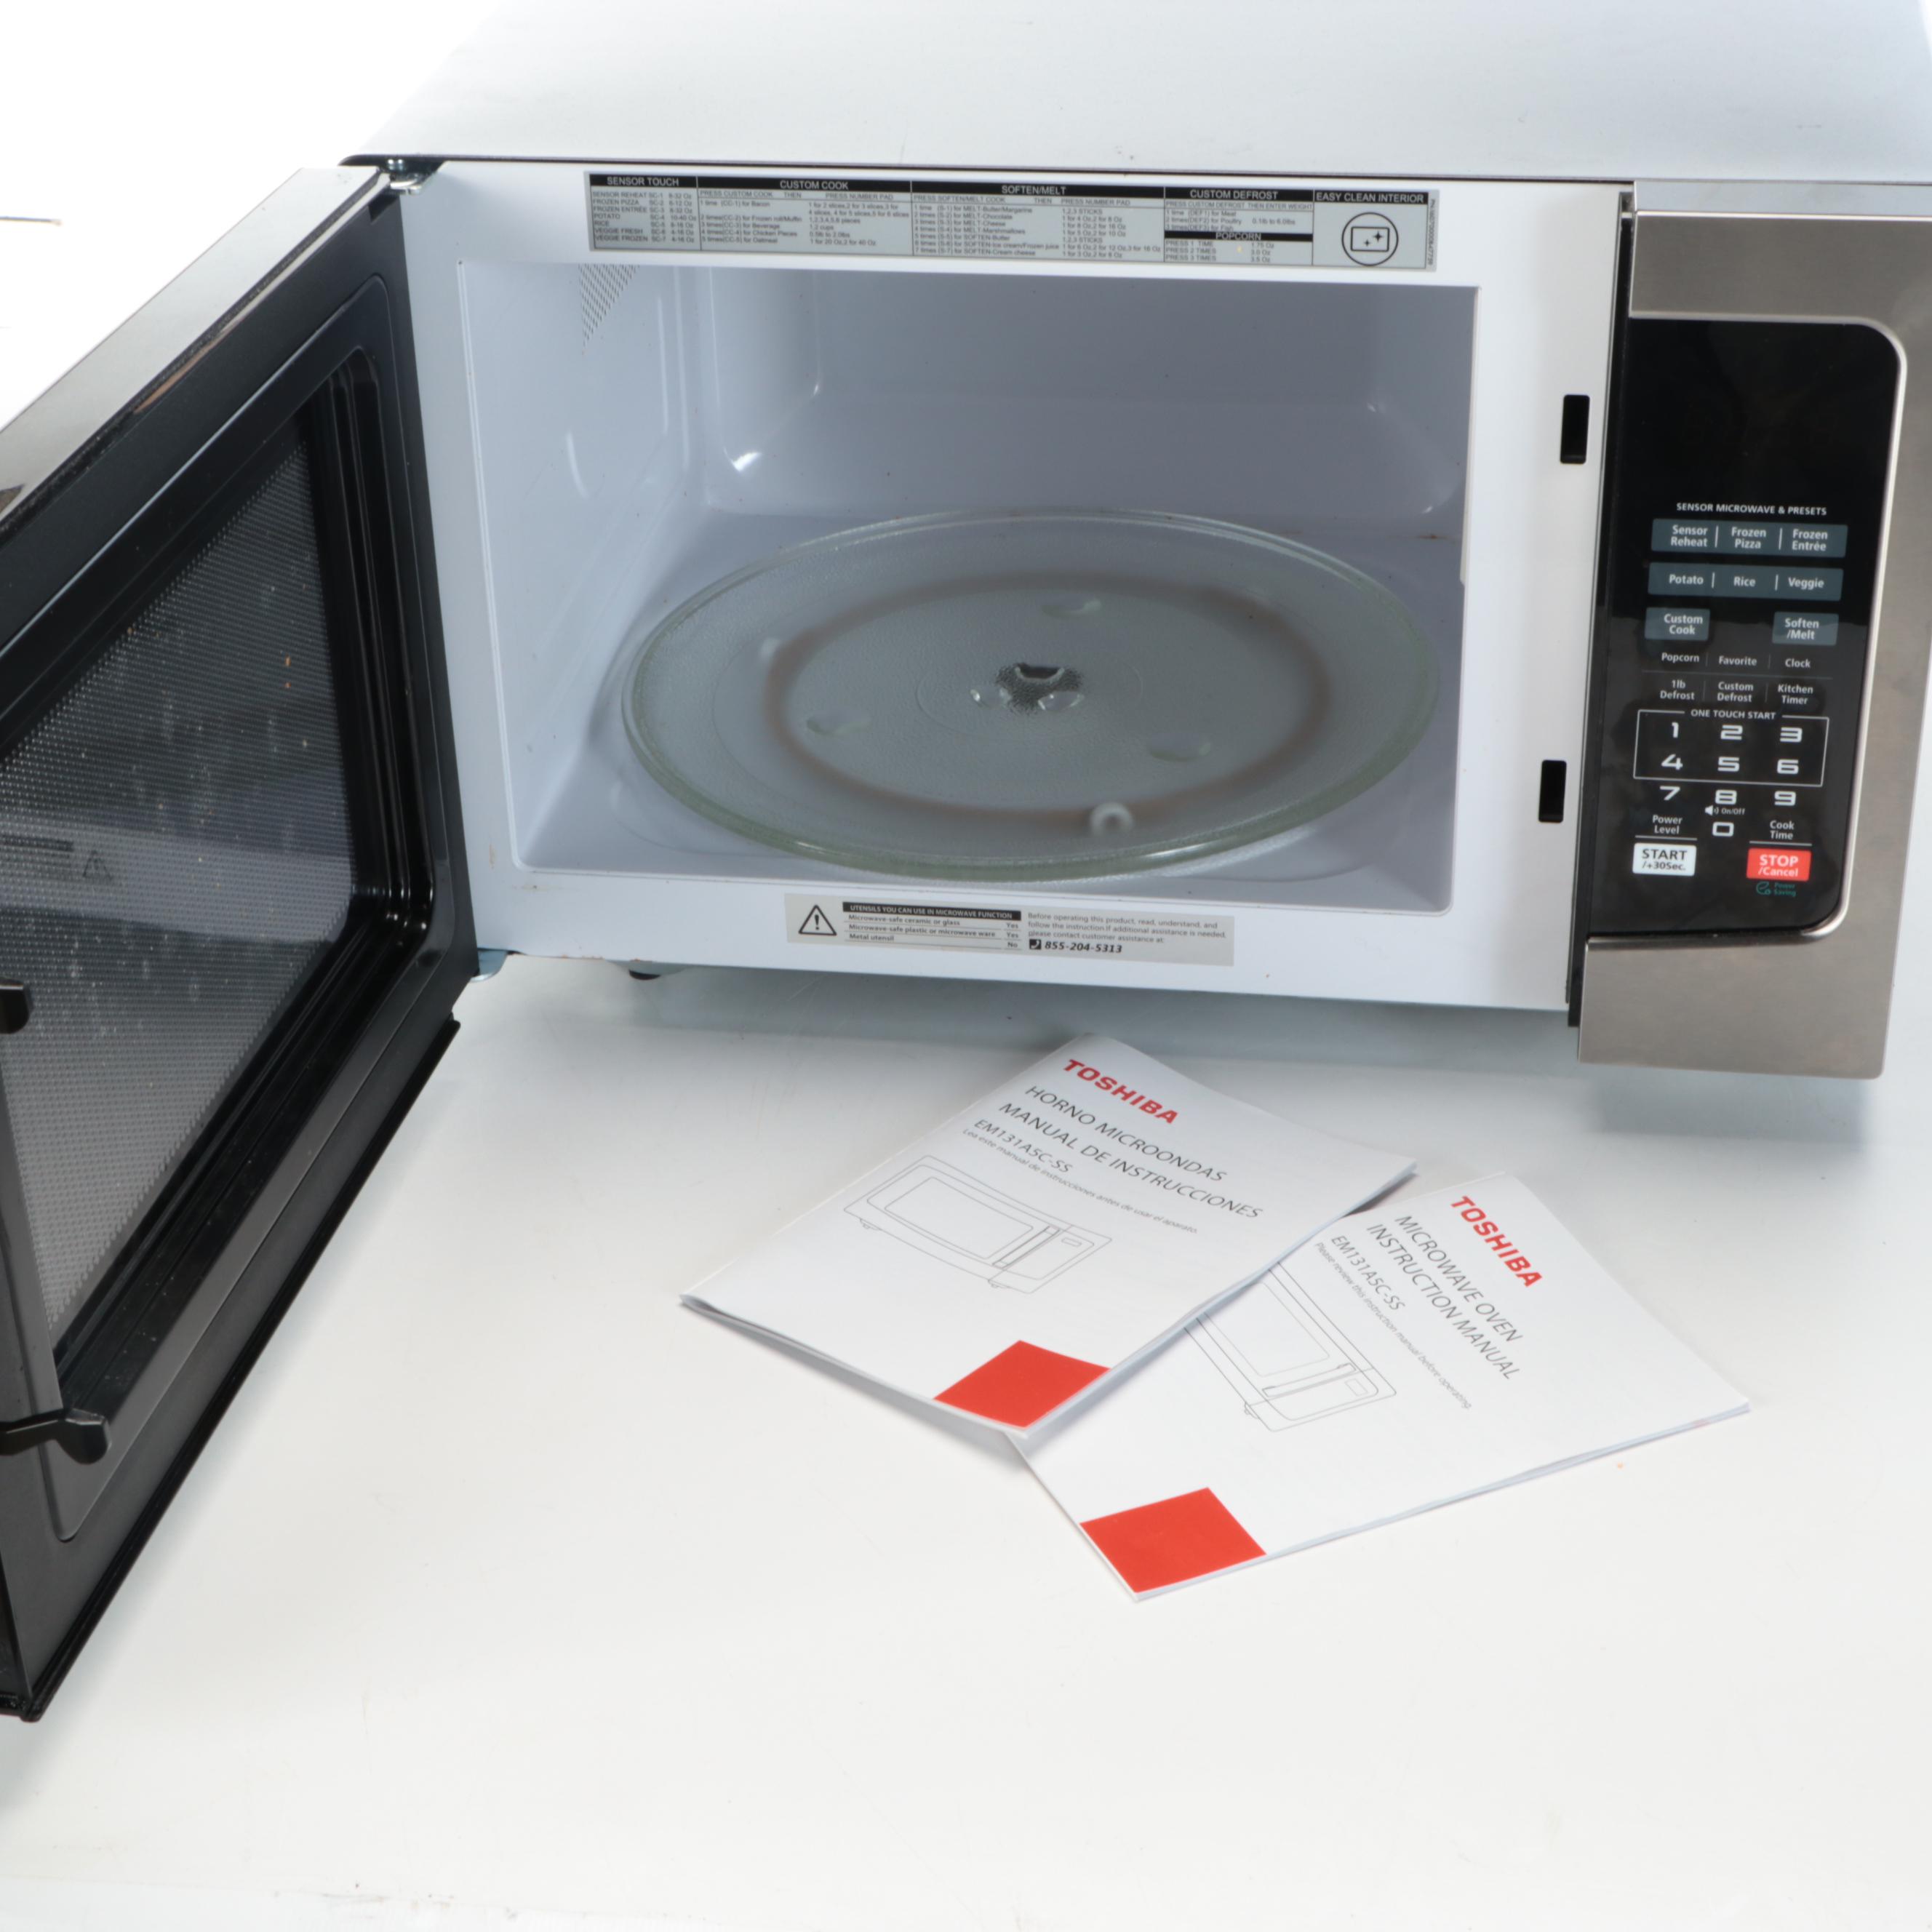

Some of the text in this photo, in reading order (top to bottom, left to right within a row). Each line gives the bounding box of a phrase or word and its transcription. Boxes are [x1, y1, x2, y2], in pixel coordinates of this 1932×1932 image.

[607, 177, 679, 186] SENSOR TOUCH
[780, 180, 848, 190] CUSTOM COOK
[1002, 185, 1066, 195] SOFTEN/MELT
[1190, 190, 1278, 199] CUSTOM DEFROST
[1317, 192, 1424, 202] EASY CLEAN INTERIOR
[1677, 503, 1827, 516] SENSOR MICROWAVE & PRESETS
[1672, 524, 1708, 535] Sensor
[1731, 527, 1766, 538] Frozen
[1792, 530, 1828, 540] Frozen
[1671, 536, 1707, 547] Reheat
[1735, 539, 1761, 549] Pizza
[1792, 540, 1827, 551] Entrée
[1669, 575, 1704, 585] Potato
[1734, 577, 1756, 587] Rice
[1789, 578, 1824, 590] Veggie
[1664, 614, 1703, 625] Custom
[1785, 618, 1819, 629] Soften
[1669, 625, 1696, 635] Cook
[1787, 629, 1816, 640] /Melt
[1661, 652, 1699, 663] Popcorn
[1719, 656, 1757, 666] Favorite
[1785, 658, 1811, 668] Clock
[1672, 679, 1685, 689] 1lb
[1718, 682, 1753, 691] Custom
[1778, 684, 1813, 694] Kitchen
[1660, 691, 1695, 700] Defrost
[1717, 693, 1752, 703] Defrost
[1781, 696, 1808, 705] Timer
[1691, 709, 1776, 720] ONE TOUCH START
[1672, 722, 1803, 743] 1 2 3
[1661, 754, 1799, 774] 4 5 6
[1660, 786, 1796, 806] 7 8 9
[1721, 807, 1745, 815] On/Off
[1653, 815, 1682, 825] Power
[1654, 826, 1680, 834] Level
[1712, 822, 1734, 837] 0
[1770, 821, 1795, 830] Cook
[1770, 831, 1793, 839] Time
[1642, 849, 1687, 860] START
[1760, 854, 1798, 867] STOP
[1642, 862, 1685, 871] /+30Sec.
[1758, 866, 1798, 877] /Cancel
[849, 914, 903, 922] Microwave-safe
[935, 909, 975, 917] MICROWAVE
[978, 911, 1013, 919] FUNCTION
[1053, 914, 1088, 922] operating
[1113, 925, 1149, 934] additional
[1045, 941, 1122, 953] 855-204-5313
[1063, 1059, 1178, 1124] TOSHIBA
[1025, 1085, 1227, 1182] HORNO MICROONDAS
[999, 1103, 1263, 1218] MANUAL DE INSTRUCCIONES
[963, 1129, 978, 1138] Lea
[978, 1135, 997, 1148] este
[997, 1146, 1030, 1165] manual
[1029, 1163, 1040, 1172] de
[1041, 1170, 1096, 1197] instrucciones
[1096, 1194, 1119, 1207] antes
[1133, 1209, 1152, 1218] usar
[1450, 1195, 1543, 1288] TOSHIBA
[1395, 1216, 1522, 1343] MICROWAVE OVEN
[1367, 1224, 1520, 1380] INSTRUCTION MANUAL
[1315, 1242, 1336, 1263] Please
[1333, 1263, 1354, 1285] review
[1352, 1285, 1366, 1298] this
[1363, 1298, 1397, 1332] instruction
[1397, 1333, 1423, 1355] manual
[1418, 1356, 1441, 1376] before
